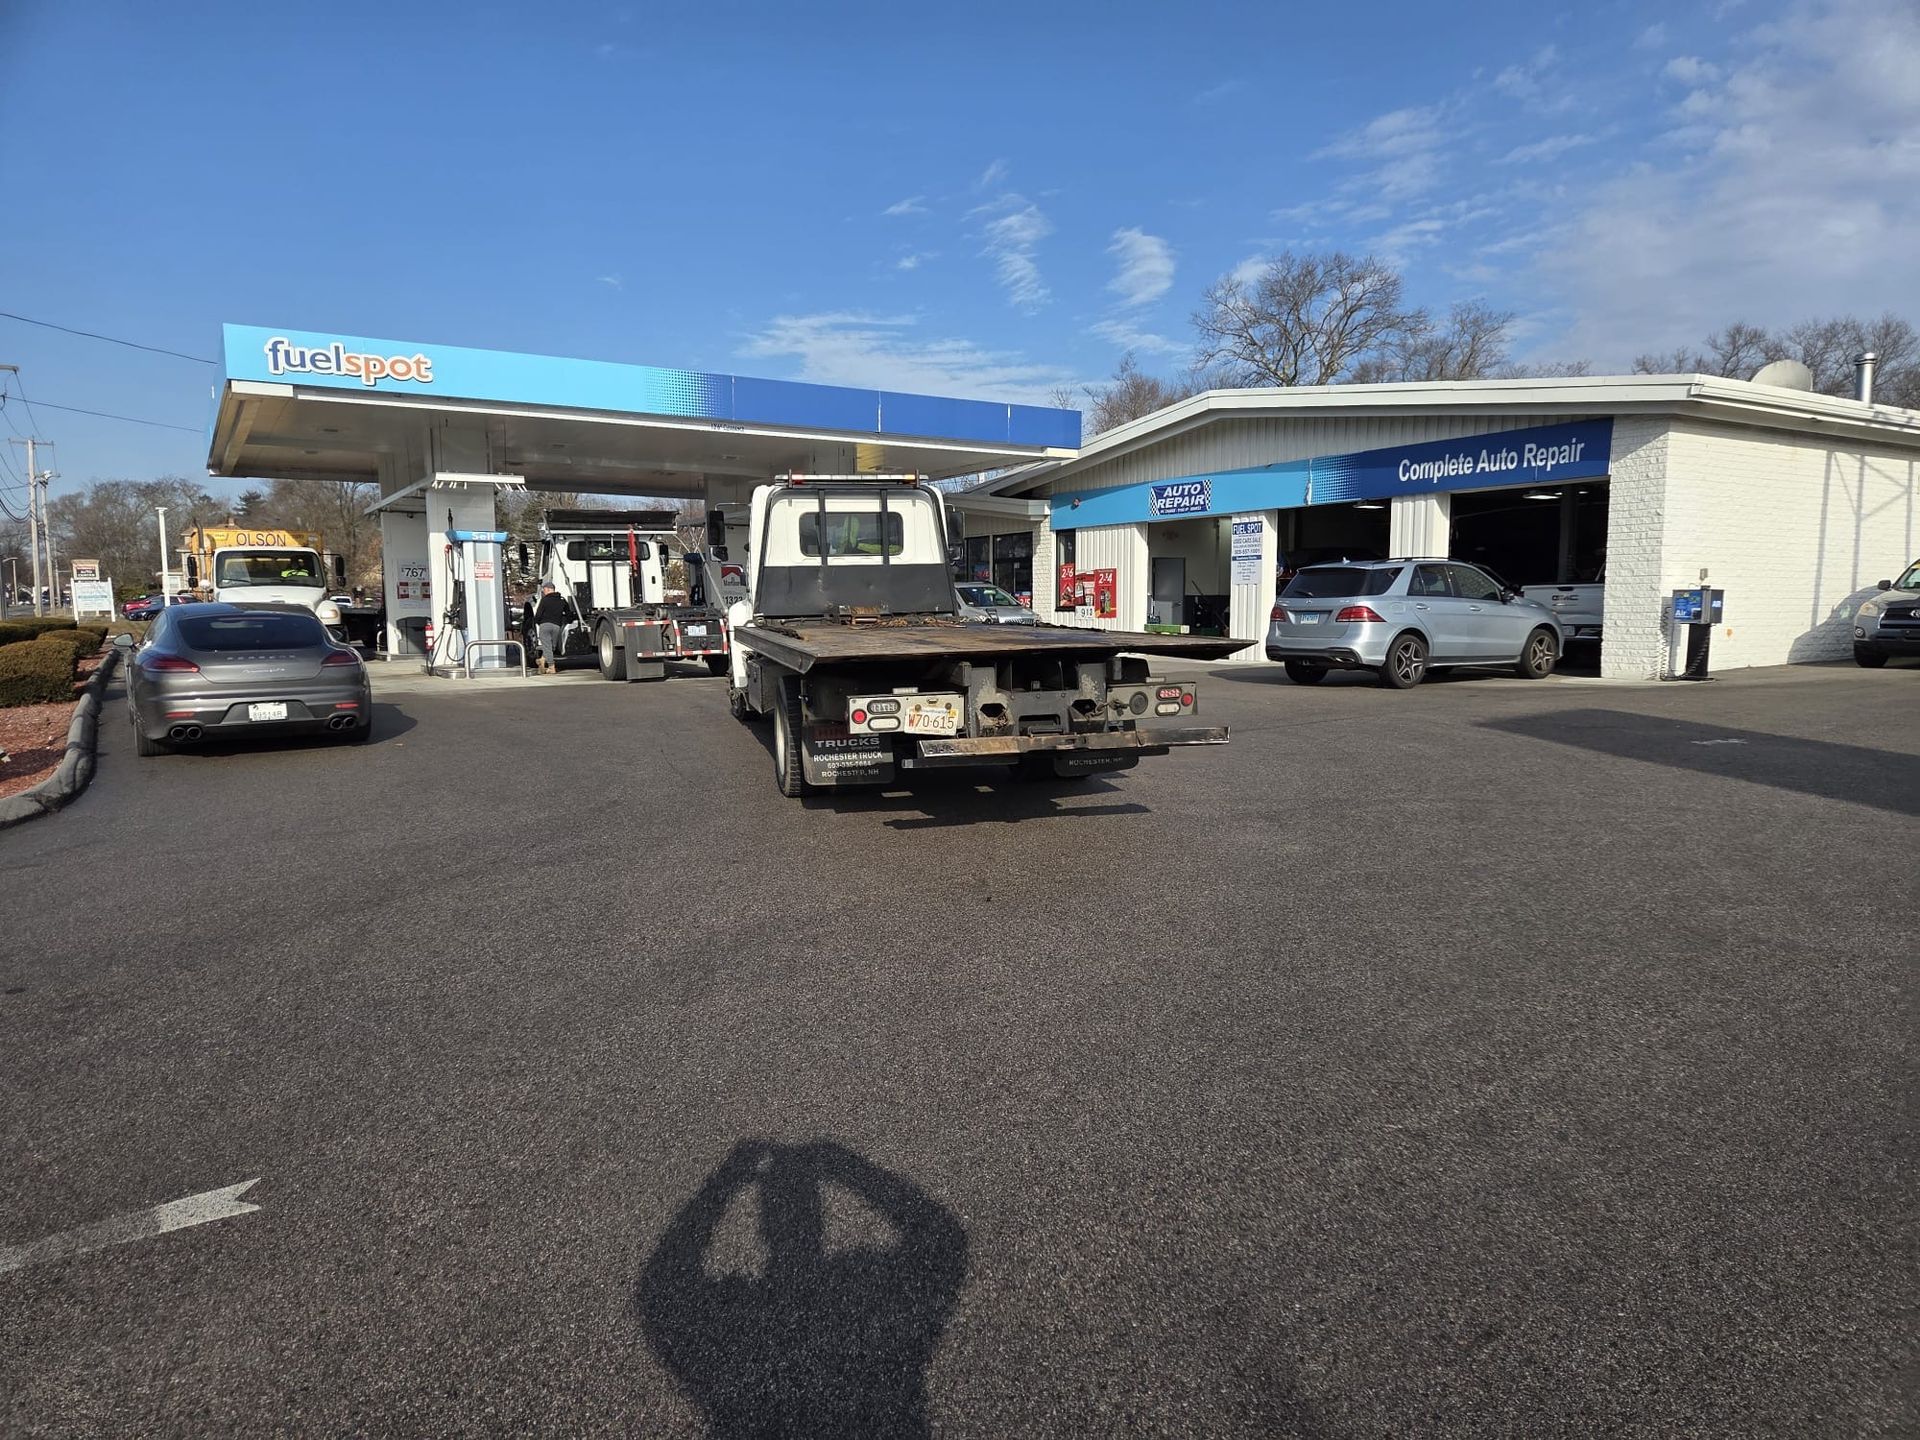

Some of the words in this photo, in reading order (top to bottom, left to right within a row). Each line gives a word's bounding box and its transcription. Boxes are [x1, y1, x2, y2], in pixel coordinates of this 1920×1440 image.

[266, 337, 432, 385] fuelspot
[1399, 454, 1474, 484] Complete
[1476, 449, 1518, 473] Auto
[1523, 437, 1585, 471] Repair
[1163, 483, 1201, 498] AUTO
[1157, 494, 1205, 509] REPAIR
[1233, 524, 1247, 535] FUEL
[1247, 522, 1262, 533] SPOT
[236, 532, 287, 547] OLSON
[814, 737, 880, 748] TRUCKS
[813, 752, 858, 762] ROCHESTER
[859, 751, 883, 760] TRUCK
